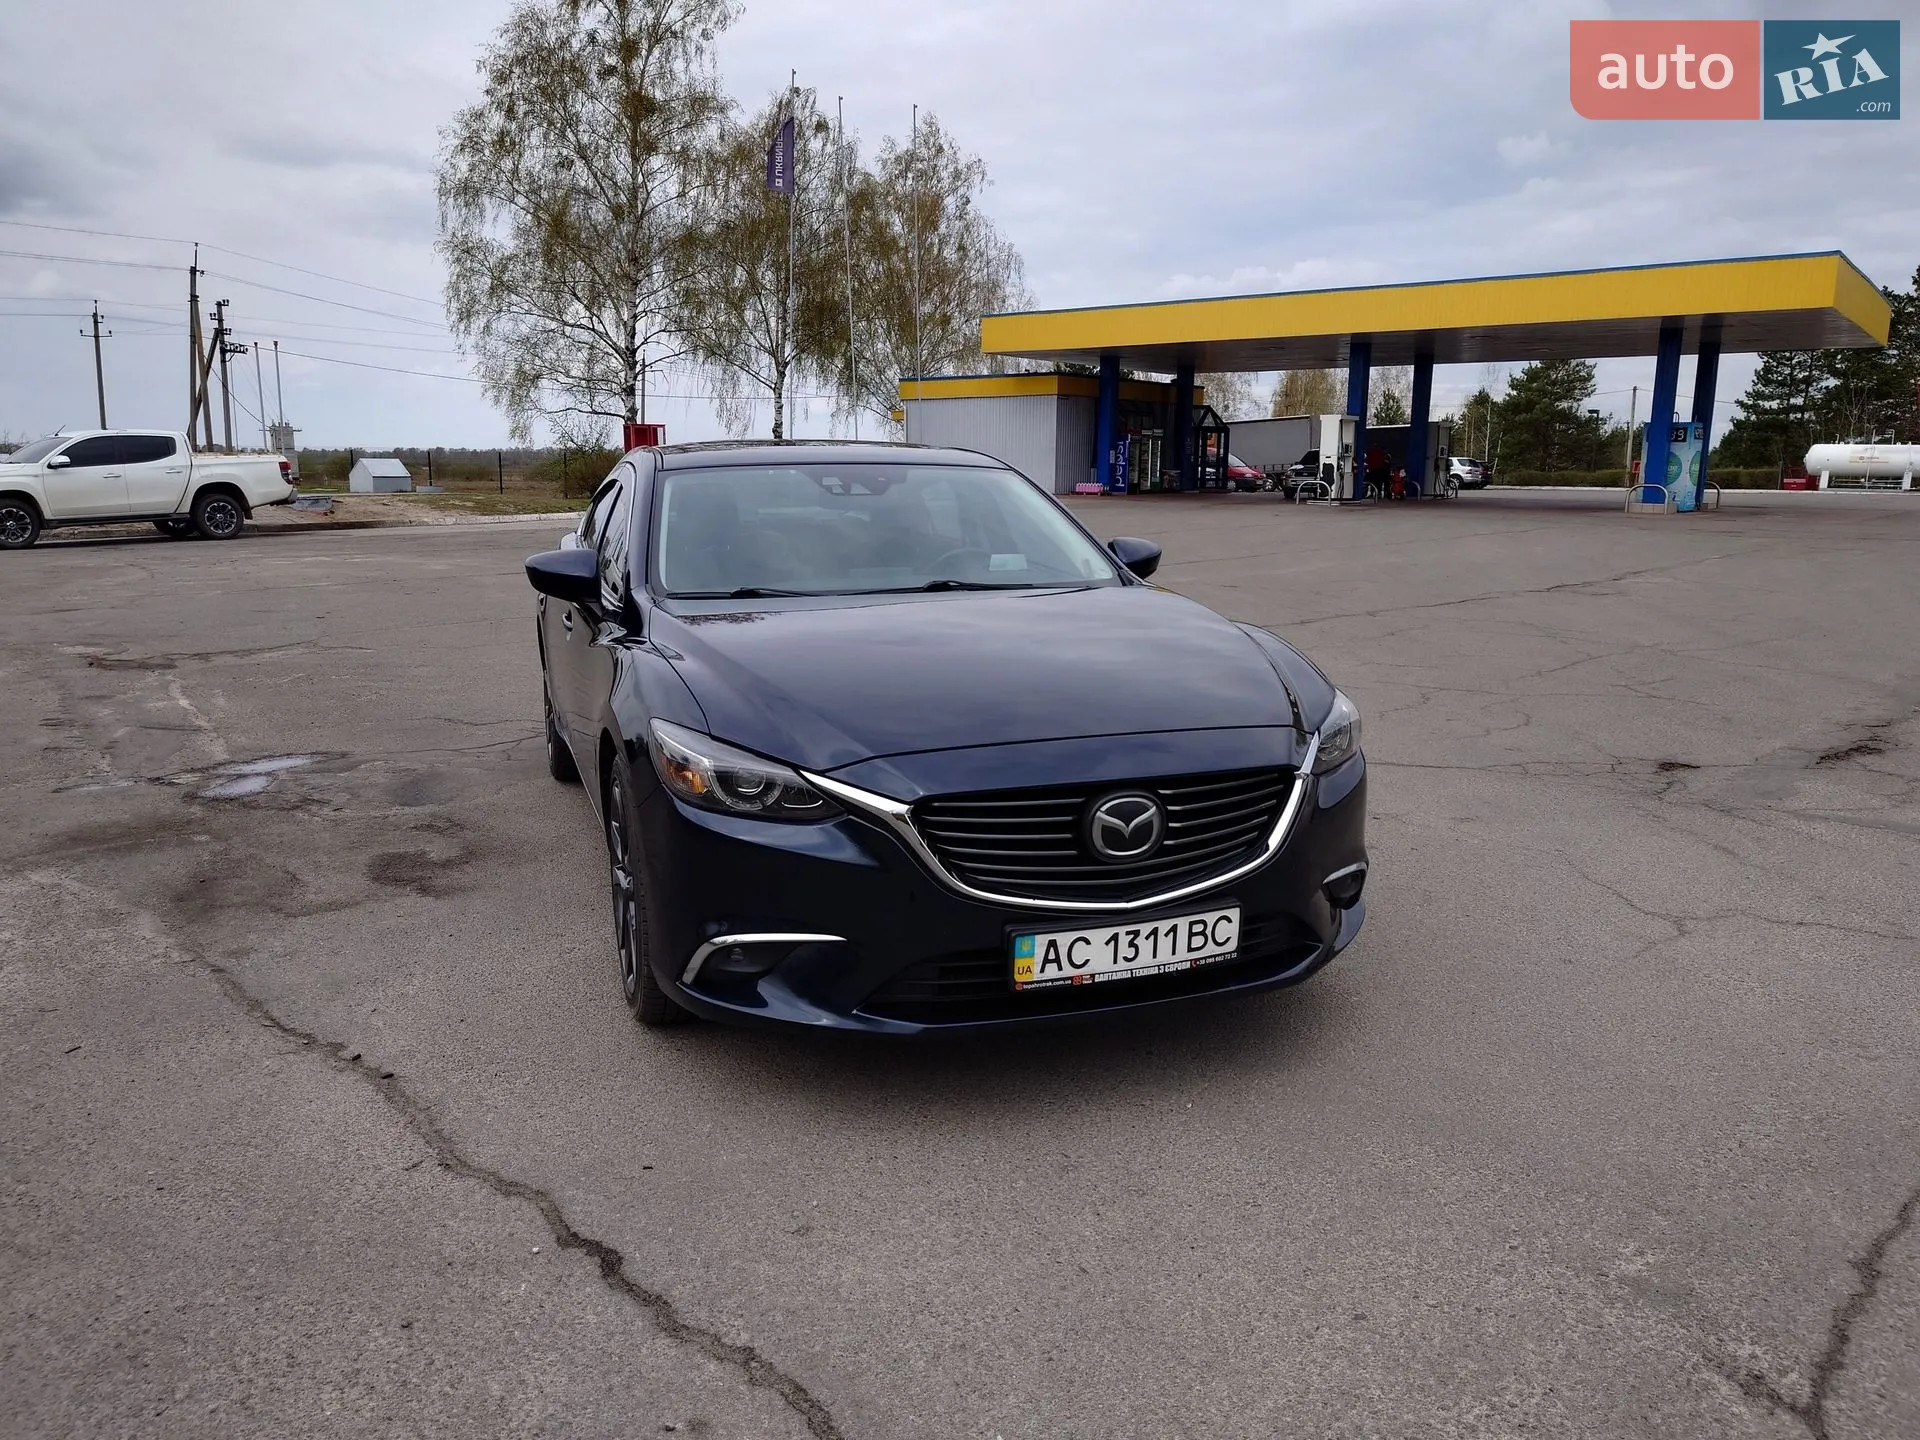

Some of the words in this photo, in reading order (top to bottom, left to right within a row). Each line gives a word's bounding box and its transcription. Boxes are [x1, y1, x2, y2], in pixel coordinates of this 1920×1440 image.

[1116, 442, 1126, 486] pepsi
[1017, 965, 1033, 976] UA
[1039, 935, 1092, 974] AC
